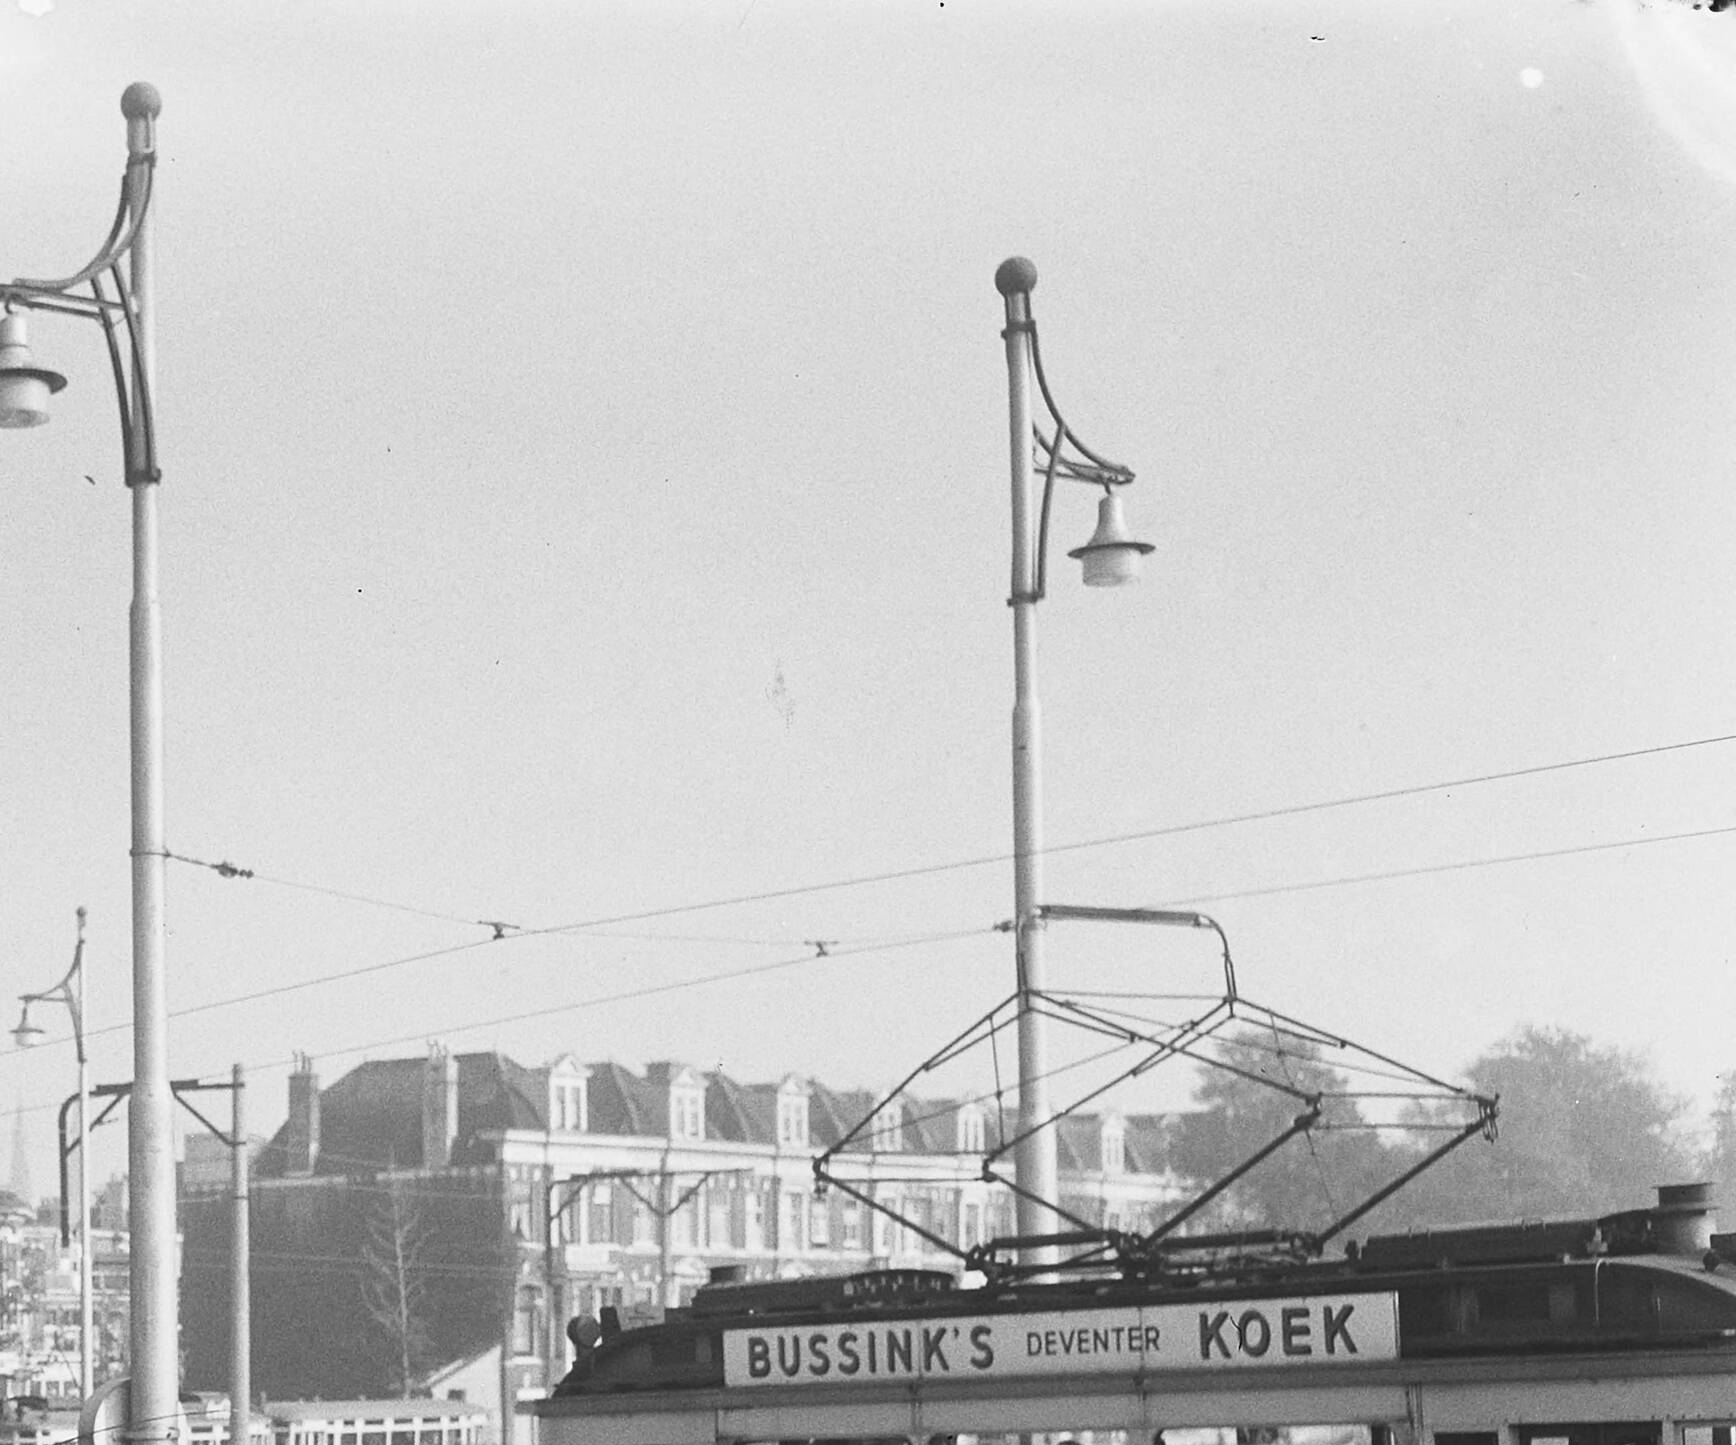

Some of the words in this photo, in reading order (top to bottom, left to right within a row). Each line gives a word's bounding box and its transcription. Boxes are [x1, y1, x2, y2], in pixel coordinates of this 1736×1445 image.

[748, 1324, 995, 1378] BUSSINK'S
[1026, 1325, 1161, 1357] DEVENTER
[1198, 1304, 1359, 1360] KOEK
